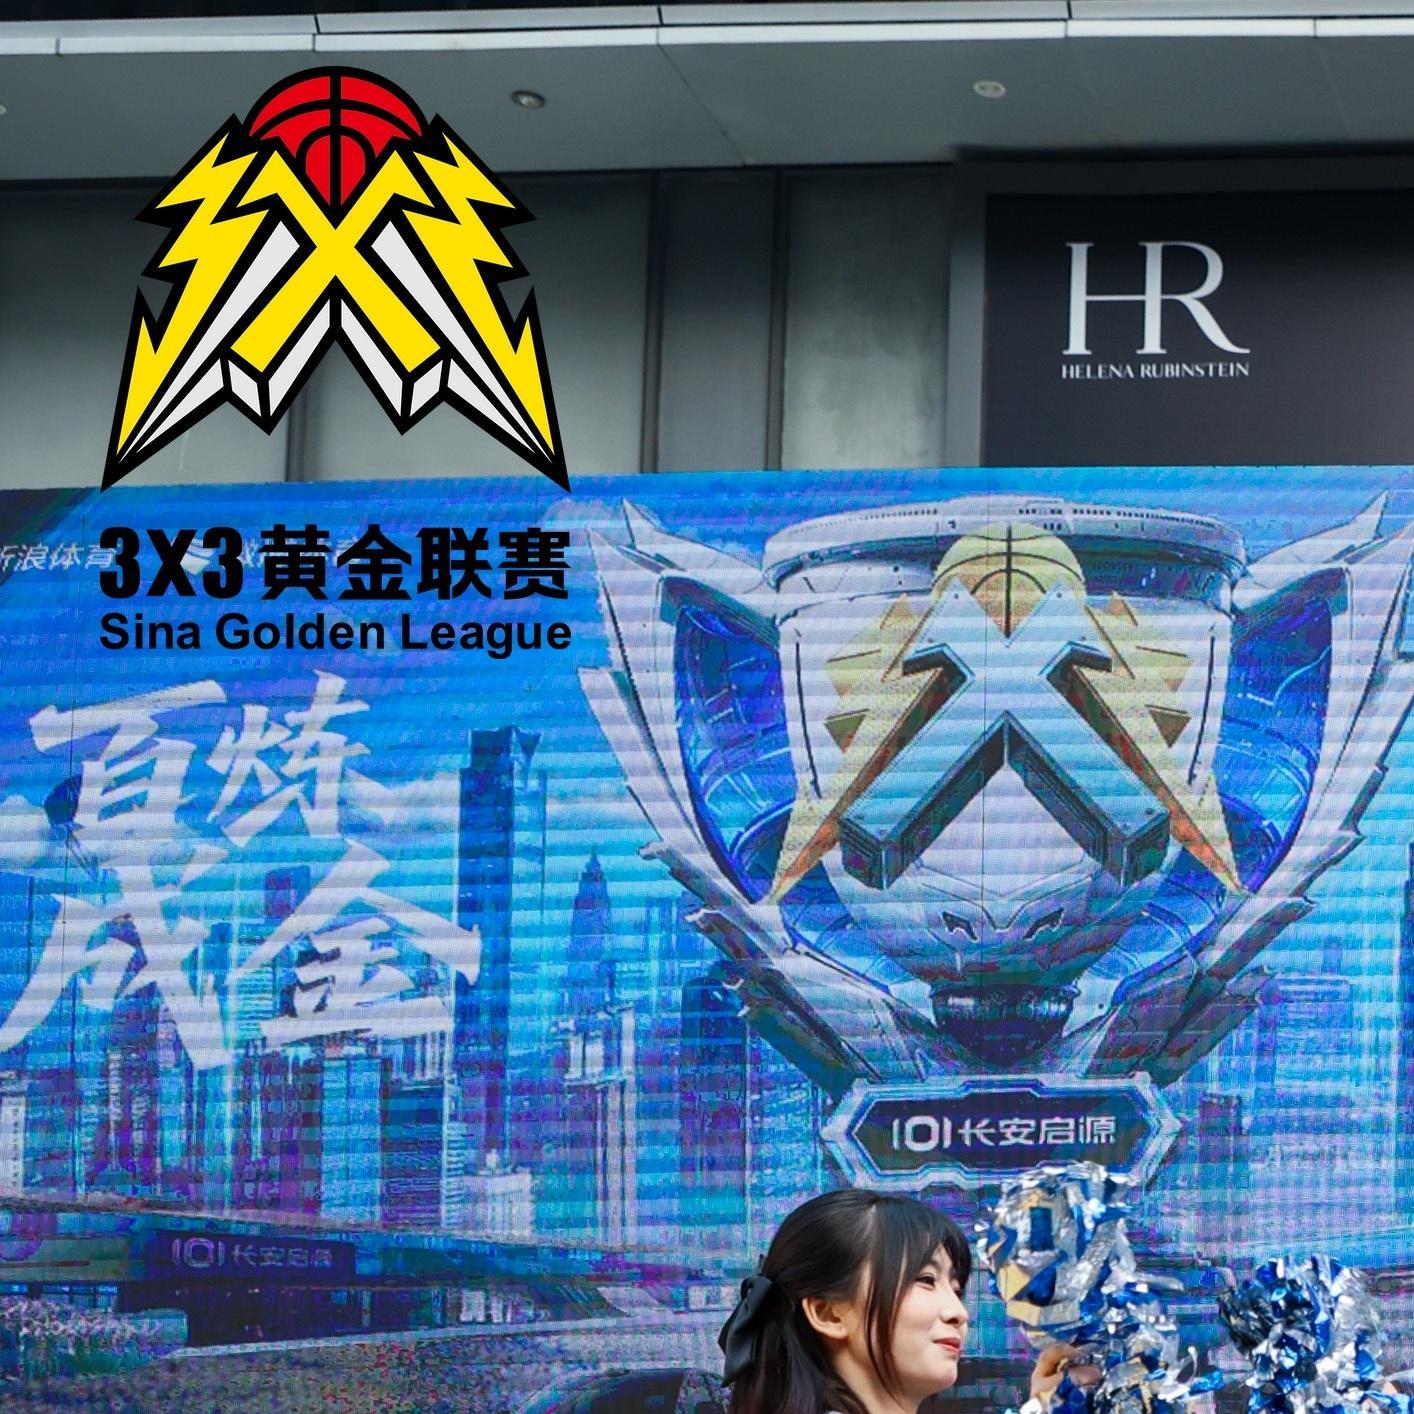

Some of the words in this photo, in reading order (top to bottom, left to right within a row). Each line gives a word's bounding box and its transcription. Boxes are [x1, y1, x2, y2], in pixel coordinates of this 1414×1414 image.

[1062, 241, 1250, 355] HR
[1062, 364, 1134, 379] HELENA
[1140, 362, 1249, 377] RUBINSTEIN
